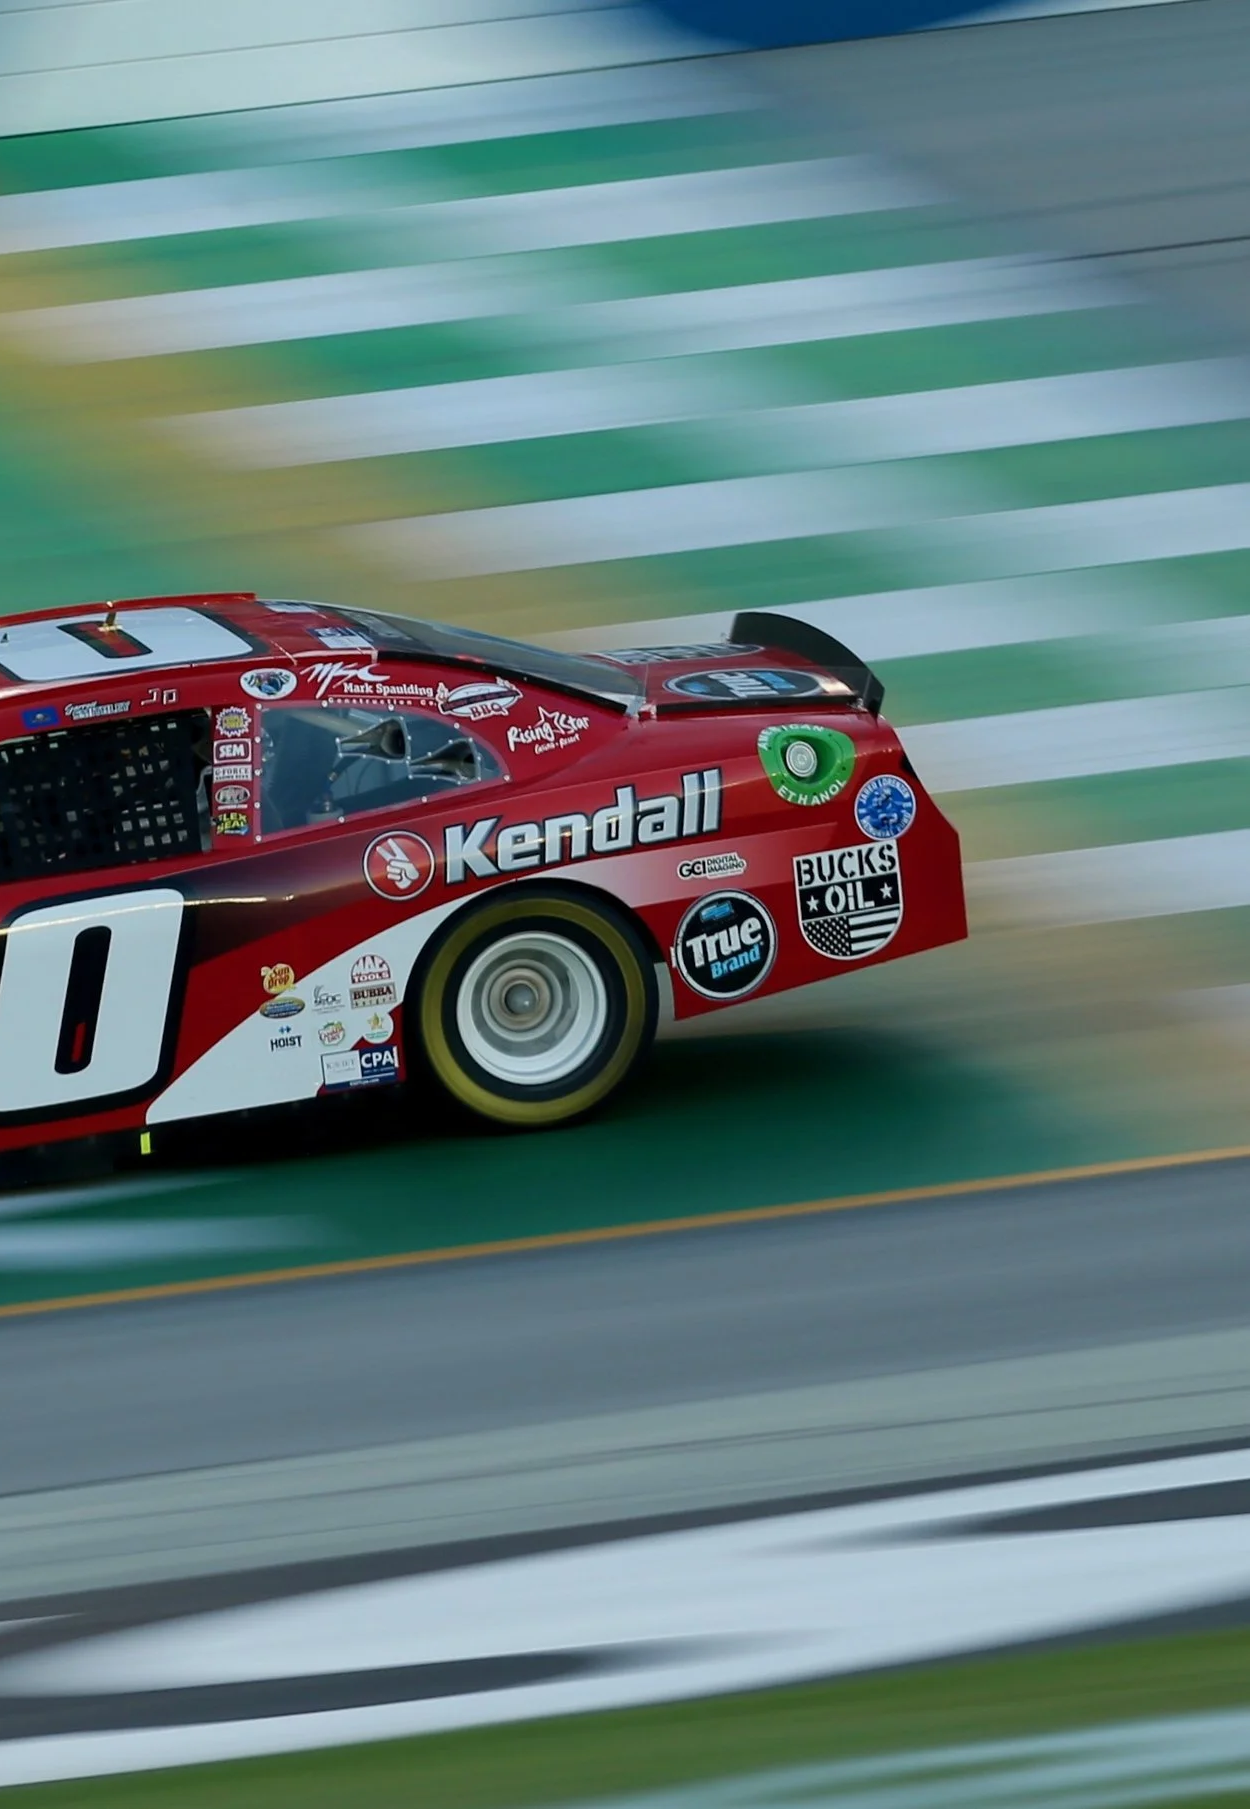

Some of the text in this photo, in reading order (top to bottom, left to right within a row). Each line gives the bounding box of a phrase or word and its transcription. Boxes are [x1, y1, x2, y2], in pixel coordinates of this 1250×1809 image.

[343, 682, 433, 697] Mark Spaulding
[470, 703, 506, 718] BBQ
[507, 714, 589, 752] Rising Star
[219, 743, 245, 758] SEM
[777, 779, 847, 806] ETHANOL
[445, 768, 722, 884] Kendall
[679, 860, 707, 877] GCI
[796, 844, 896, 887] BUCKS
[825, 881, 875, 914] OIL
[686, 917, 762, 968] True
[711, 944, 761, 979] Brand
[353, 971, 389, 983] TOOLS
[354, 986, 392, 1000] BUBBA
[270, 1035, 302, 1052] HOIST
[361, 1051, 394, 1068] CPA
